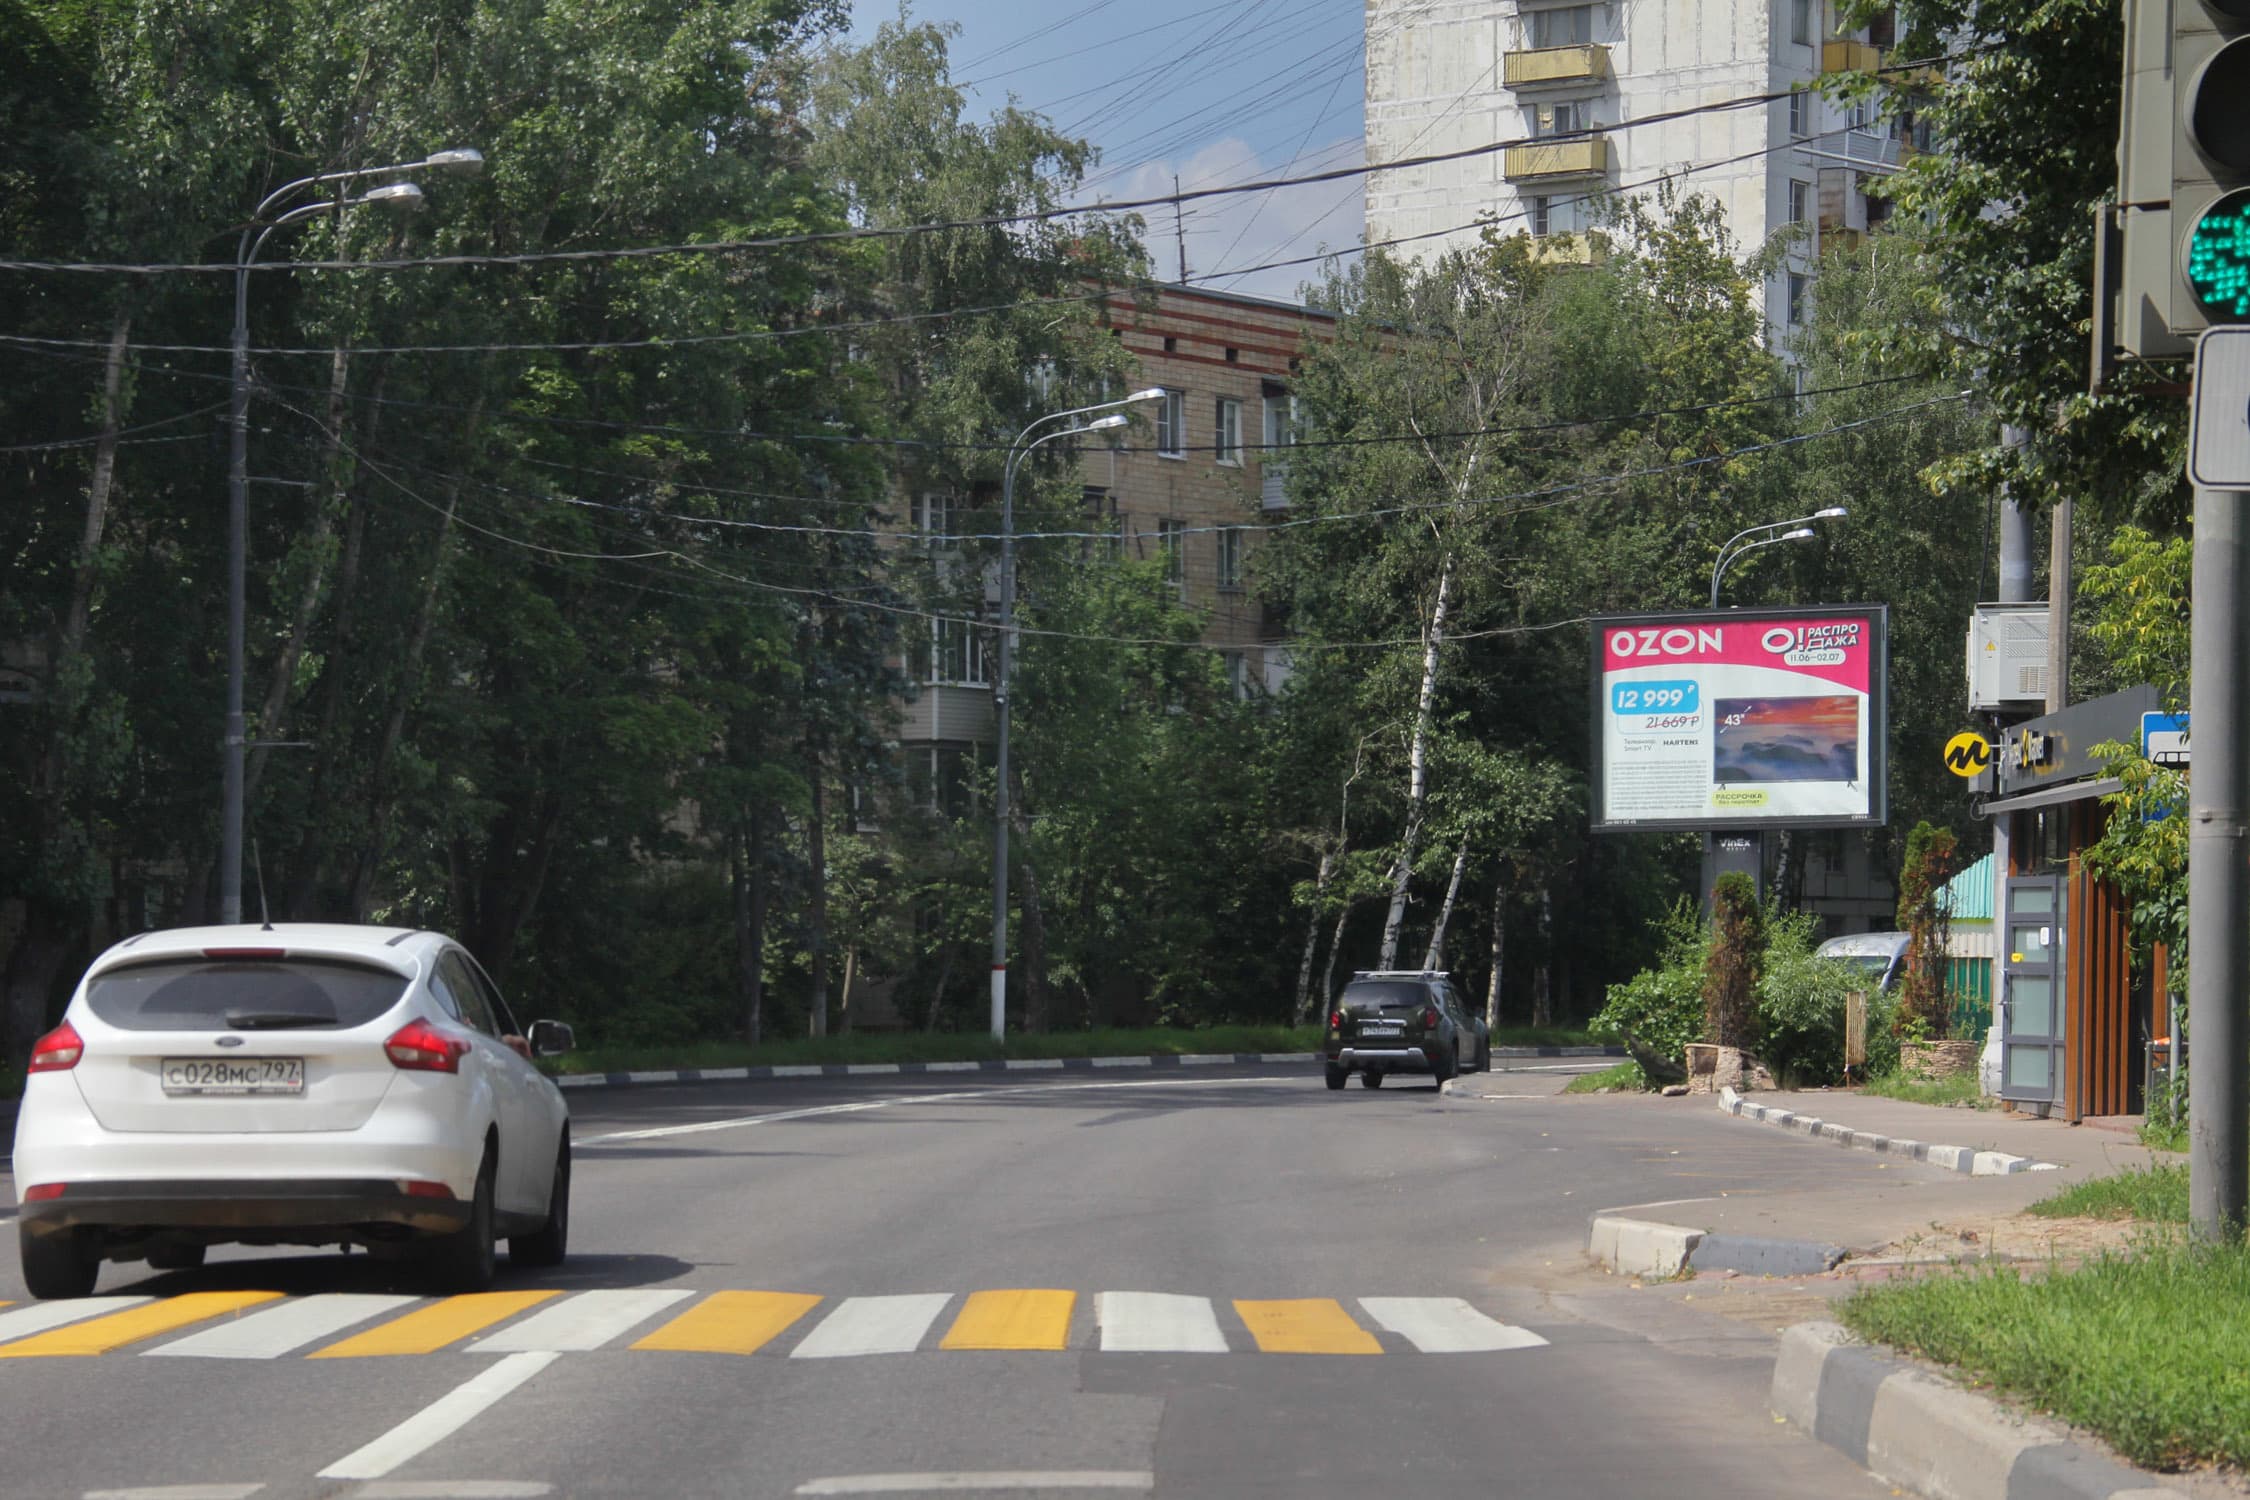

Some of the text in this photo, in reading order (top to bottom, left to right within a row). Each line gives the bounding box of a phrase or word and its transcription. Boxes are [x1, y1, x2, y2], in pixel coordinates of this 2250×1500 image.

[1807, 623, 1859, 638] РАСПРО
[1610, 627, 1723, 657] OZON
[1806, 635, 1858, 651] ДАЖА
[1617, 690, 1639, 709] 12
[1643, 688, 1684, 708] 999
[264, 1061, 297, 1079] 797
